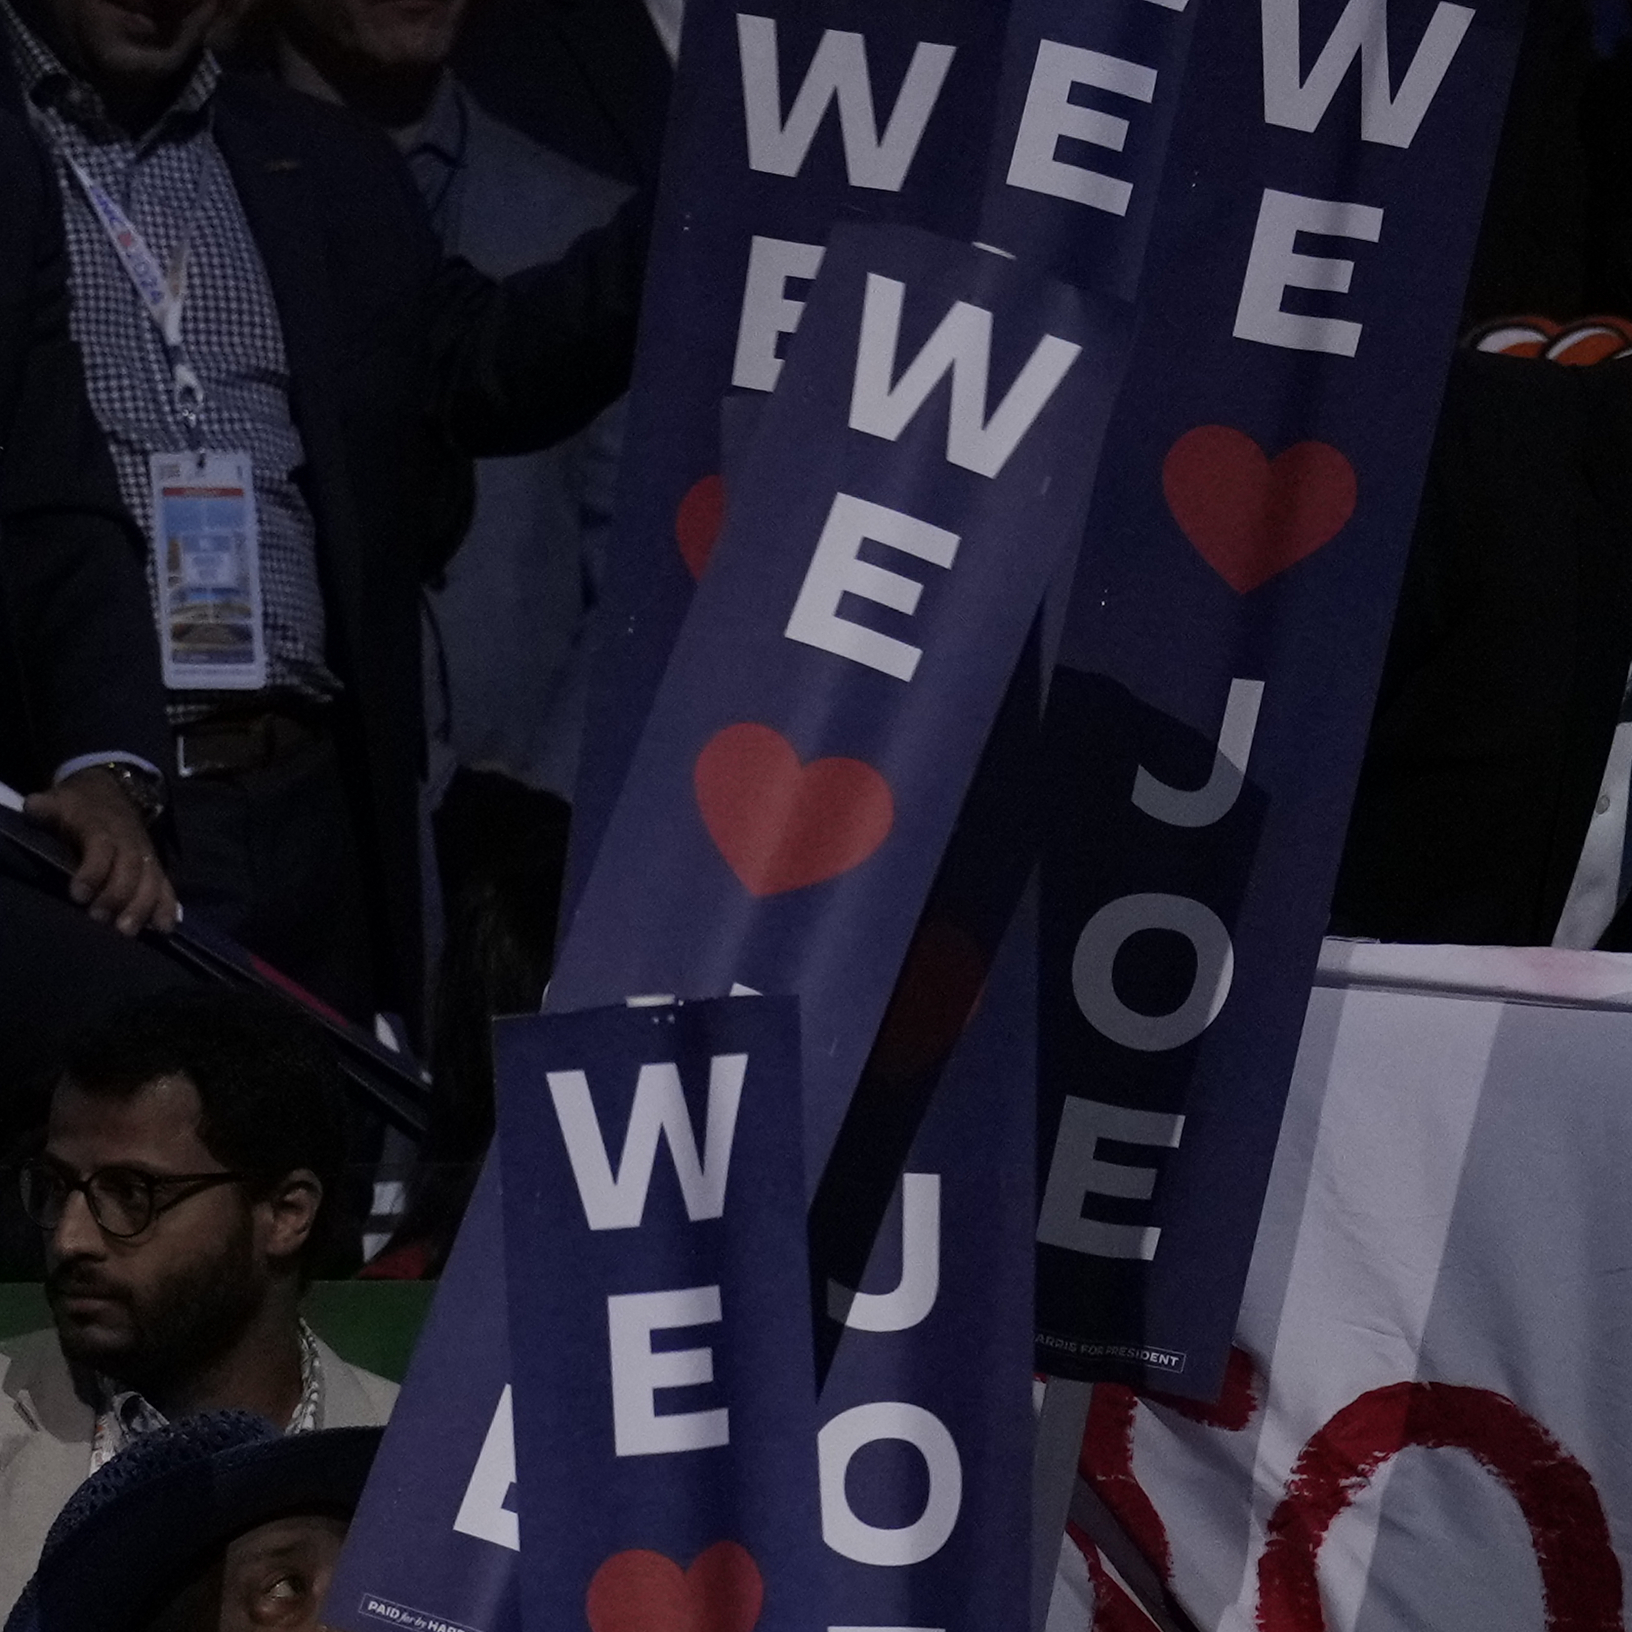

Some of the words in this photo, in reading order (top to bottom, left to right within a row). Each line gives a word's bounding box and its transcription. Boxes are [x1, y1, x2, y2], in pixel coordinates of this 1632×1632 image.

[1006, 0, 1190, 217] E
[1233, 0, 1478, 358] WE
[784, 272, 1083, 683] WE
[1036, 678, 1265, 1261] JOE
[546, 1053, 749, 1458] WE
[1034, 1333, 1078, 1353] ARRIS
[1105, 1345, 1180, 1367] PRESIDENT
[366, 1600, 400, 1619] PAID
